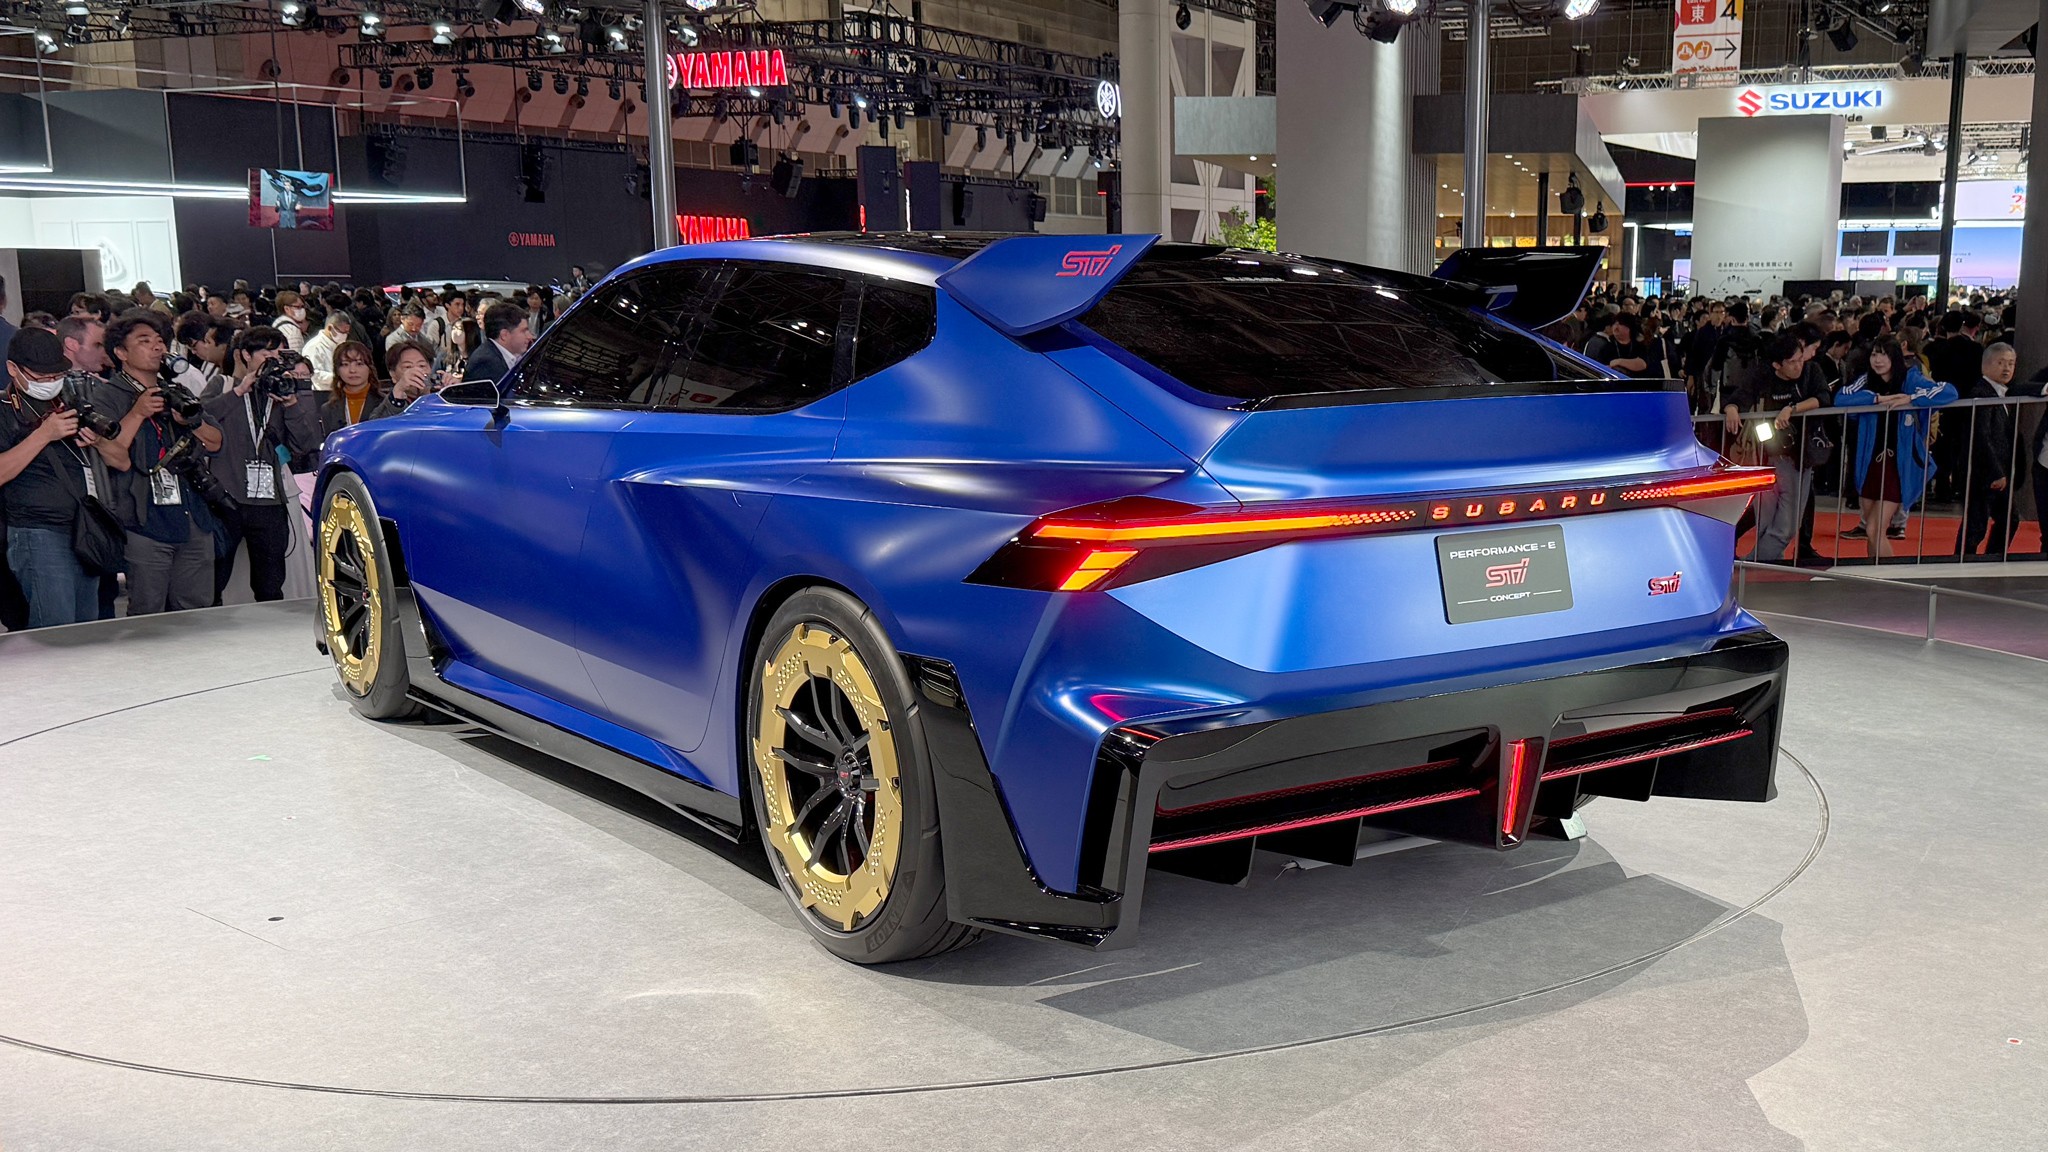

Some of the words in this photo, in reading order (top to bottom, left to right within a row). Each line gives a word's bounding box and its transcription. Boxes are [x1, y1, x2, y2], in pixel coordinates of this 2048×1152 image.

[1691, 4, 1705, 23] 東
[1720, 0, 1737, 20] 4
[676, 49, 788, 89] YAMAHA
[1770, 90, 1882, 110] SUZUKI
[519, 233, 556, 246] YAMAHA
[675, 214, 750, 245] YAMAHA
[1431, 492, 1606, 520] SUBARU
[1449, 543, 1538, 560] PERFORMANCE
[1548, 541, 1557, 550] E
[1490, 592, 1531, 602] CONCEPT
